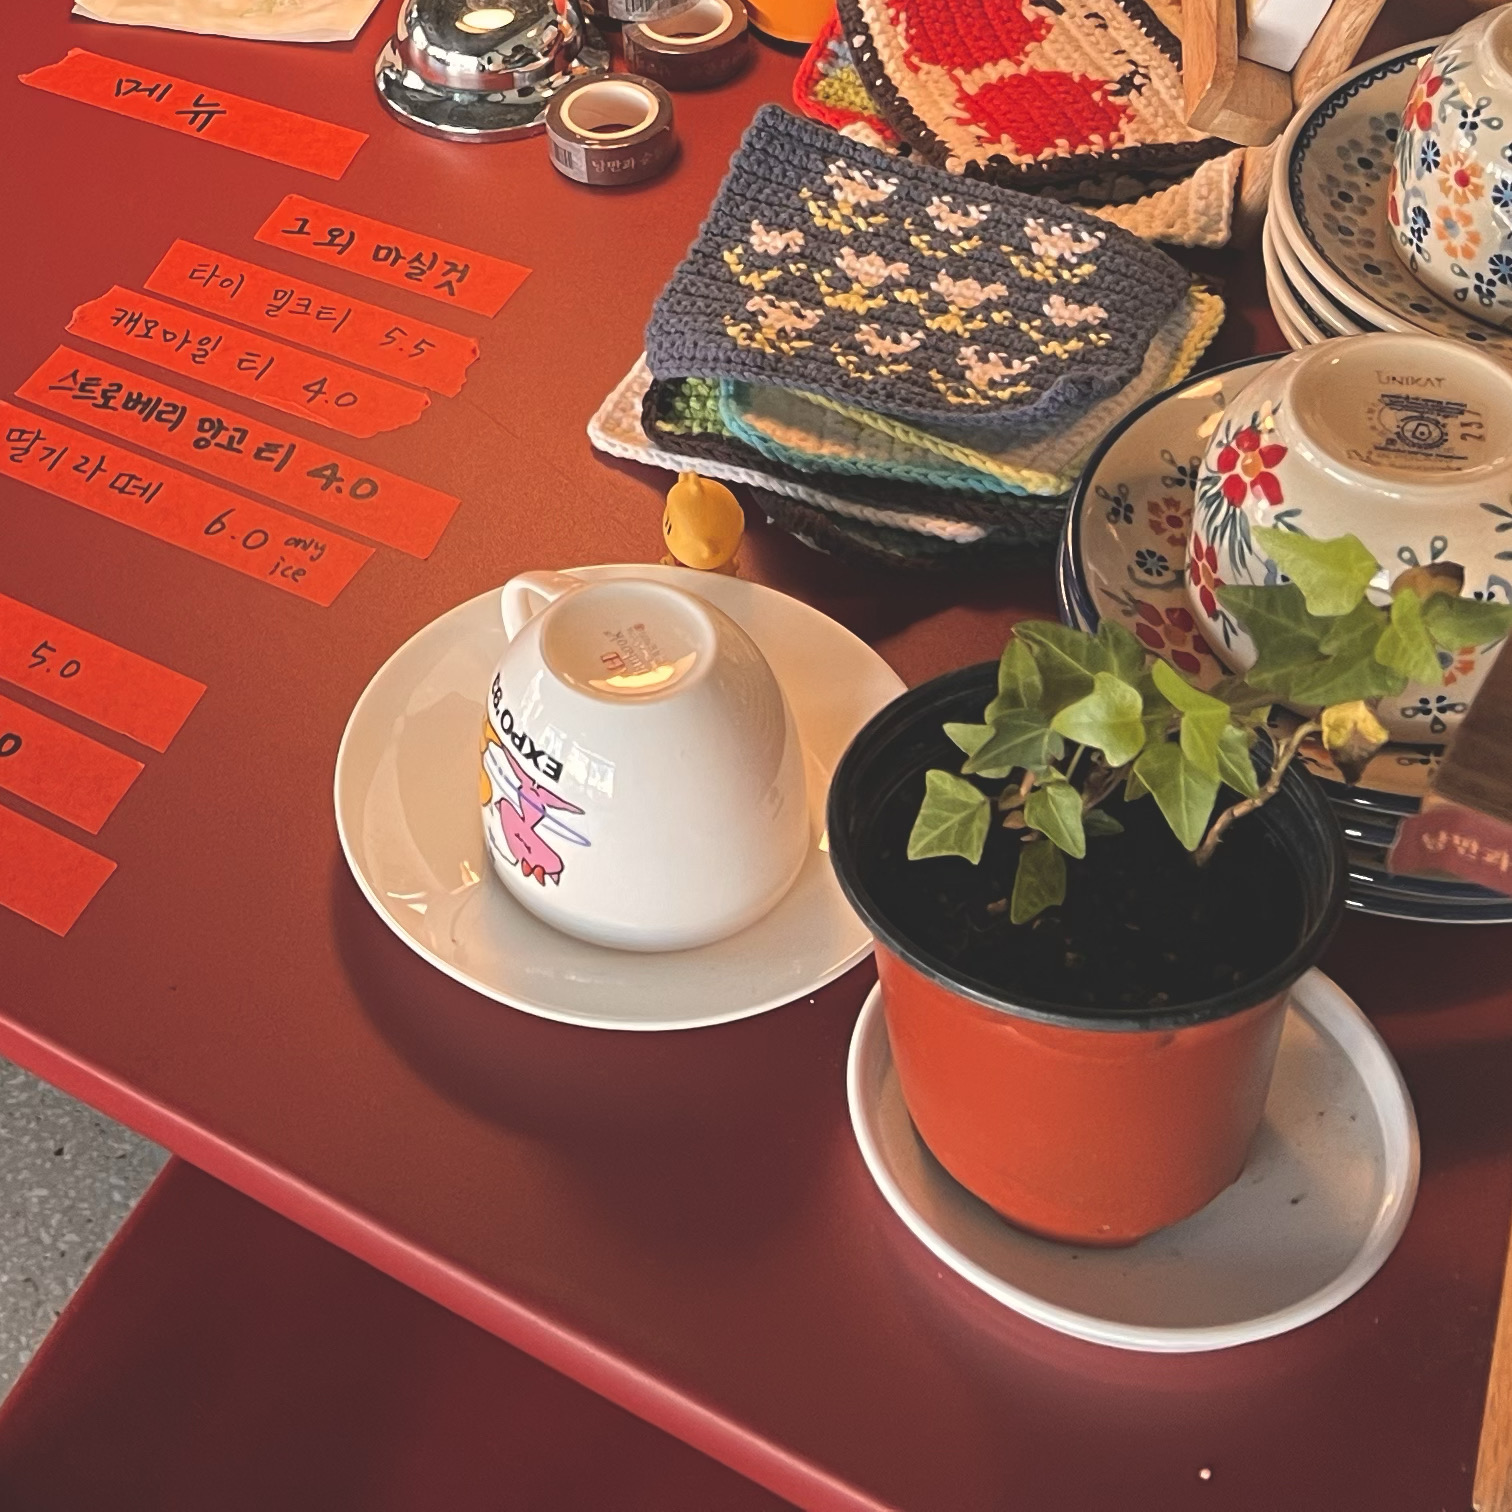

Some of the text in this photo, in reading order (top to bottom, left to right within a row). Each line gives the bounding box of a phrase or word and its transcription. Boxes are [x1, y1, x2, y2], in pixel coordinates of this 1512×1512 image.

[372, 242, 472, 297] 마실것
[188, 262, 437, 360] 타이 밀크티 5.5
[109, 306, 359, 409] 캐모마일 티 4.0
[1375, 370, 1447, 388] UNIKAT
[48, 368, 188, 434] 스트로베리
[307, 462, 380, 502] 4.0
[203, 507, 270, 552] 6.0
[283, 536, 327, 561] only
[269, 558, 307, 584] ice
[28, 640, 82, 680] 5.0
